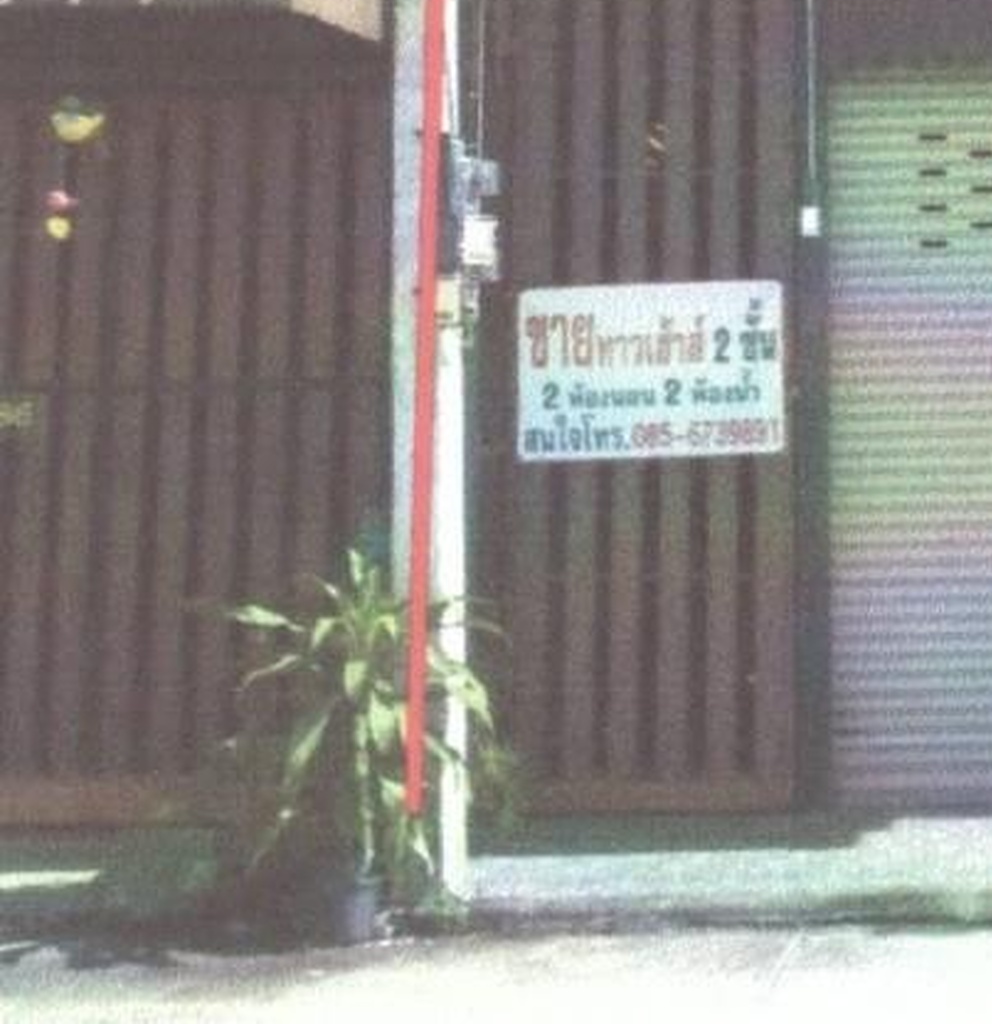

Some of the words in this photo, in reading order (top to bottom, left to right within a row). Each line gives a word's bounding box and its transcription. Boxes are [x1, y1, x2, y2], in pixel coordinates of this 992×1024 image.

[713, 326, 731, 364] 2
[738, 297, 778, 364] ชั้น
[541, 381, 560, 410] 2
[663, 377, 682, 406] 2
